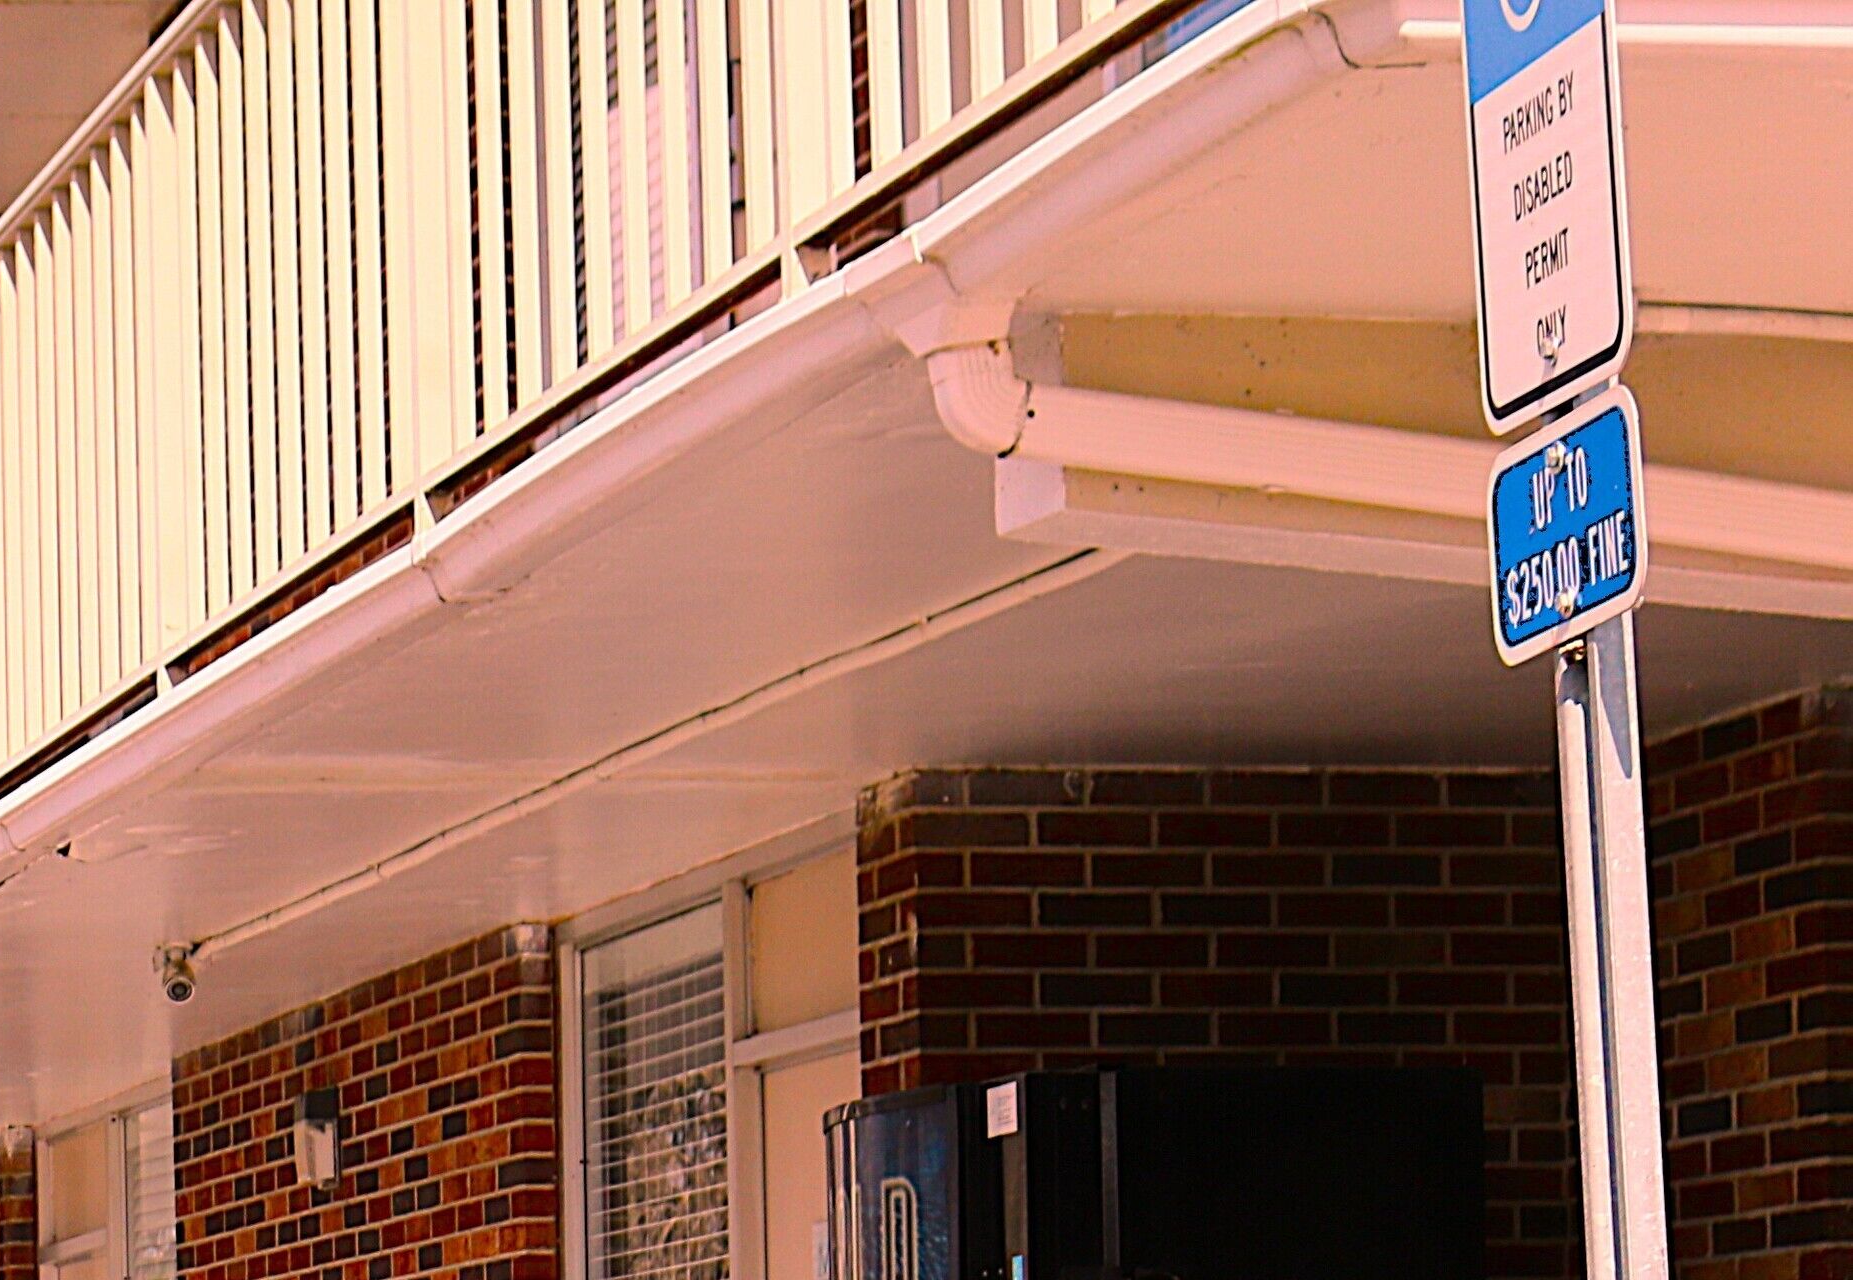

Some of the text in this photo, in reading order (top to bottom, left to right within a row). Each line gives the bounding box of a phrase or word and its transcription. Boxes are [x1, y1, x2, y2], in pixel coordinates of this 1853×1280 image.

[1502, 69, 1574, 155] PARKING BY
[1513, 149, 1574, 222] DISABLED
[1524, 226, 1569, 290] PERMIT
[1535, 303, 1567, 358] ONLY
[1532, 446, 1588, 530] UP TO
[1506, 509, 1630, 630] $25000 FINE
